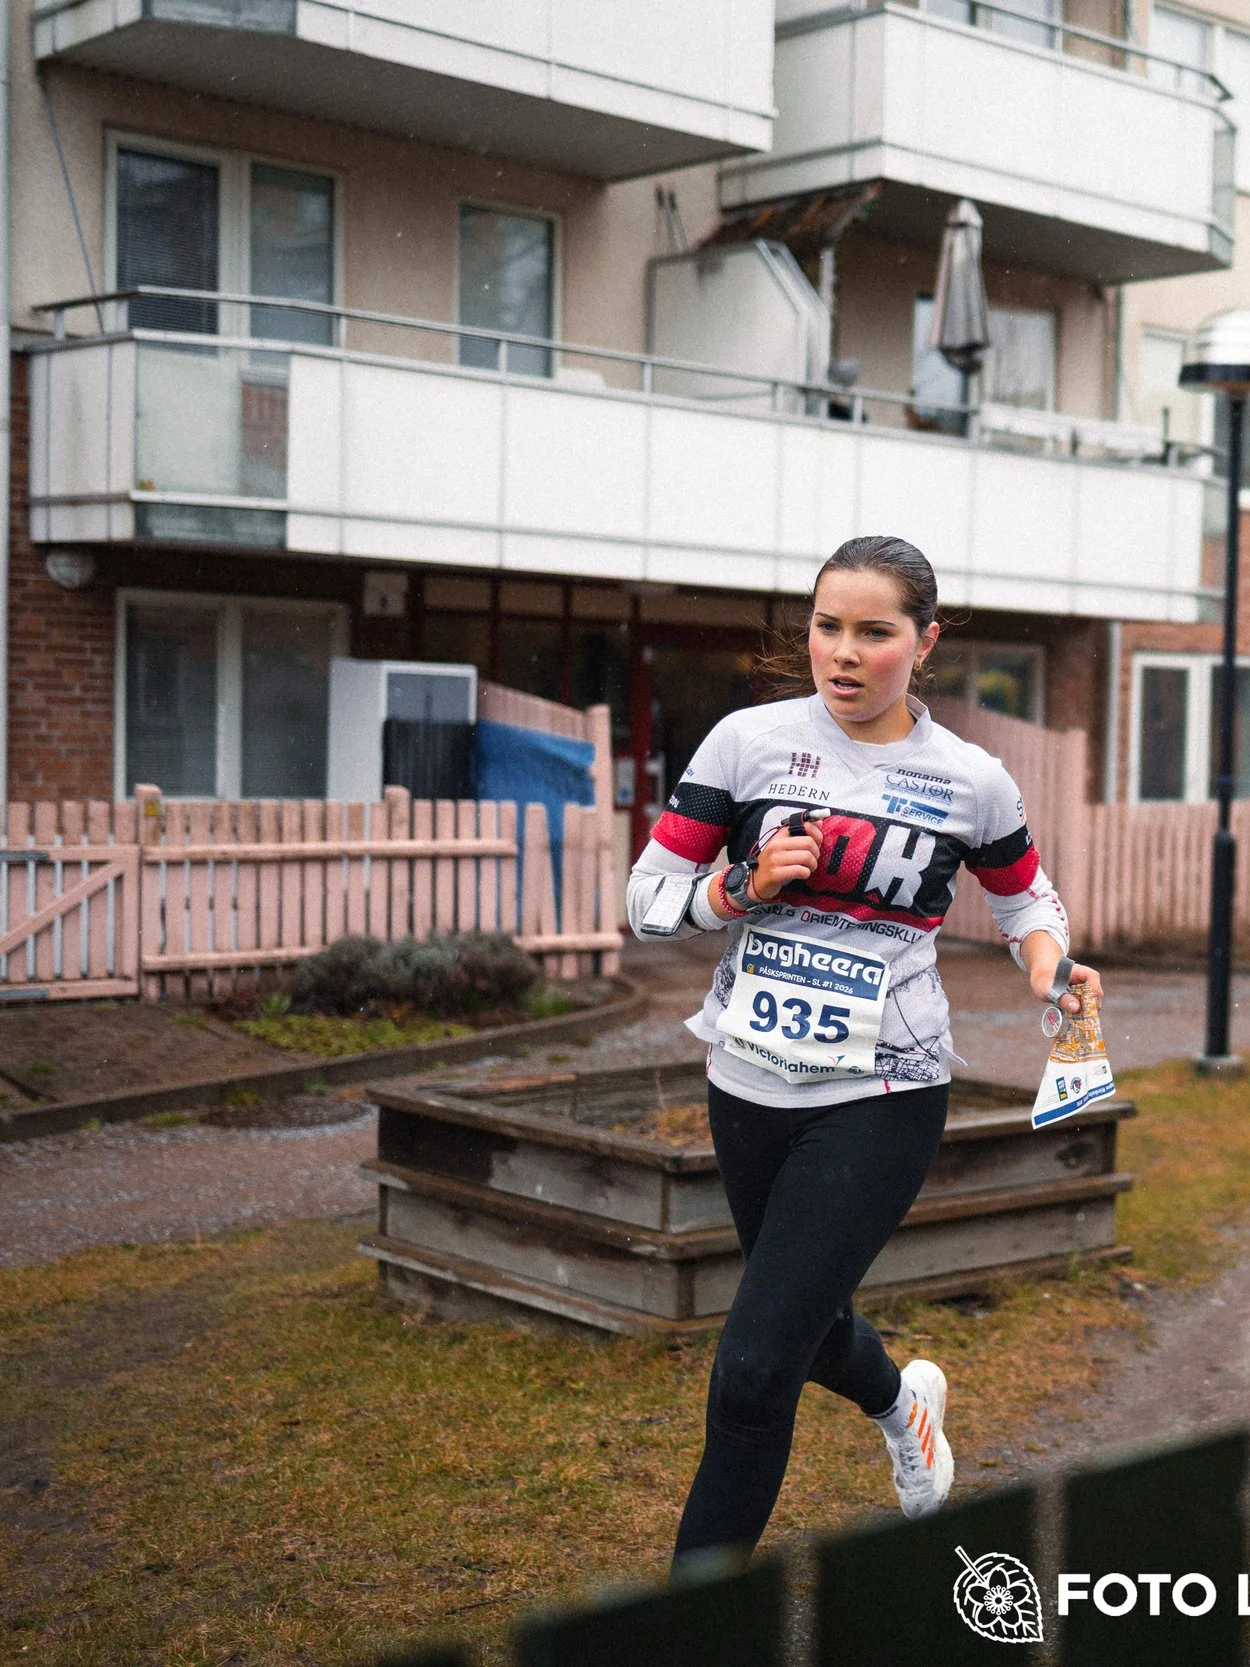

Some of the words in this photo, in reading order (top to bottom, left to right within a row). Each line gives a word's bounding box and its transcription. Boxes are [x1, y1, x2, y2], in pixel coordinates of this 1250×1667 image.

[768, 783, 830, 801] HEDERN
[886, 774, 954, 801] CASTOR
[903, 806, 944, 825] SERVICE
[758, 805, 936, 909] OK
[745, 932, 884, 986] bagheera
[759, 966, 806, 984] PÅSKSPRINTEN
[811, 978, 821, 987] SL
[822, 980, 832, 989] #1
[833, 983, 854, 994] 2026
[749, 990, 851, 1044] 935
[746, 1041, 835, 1074] Victoriahem
